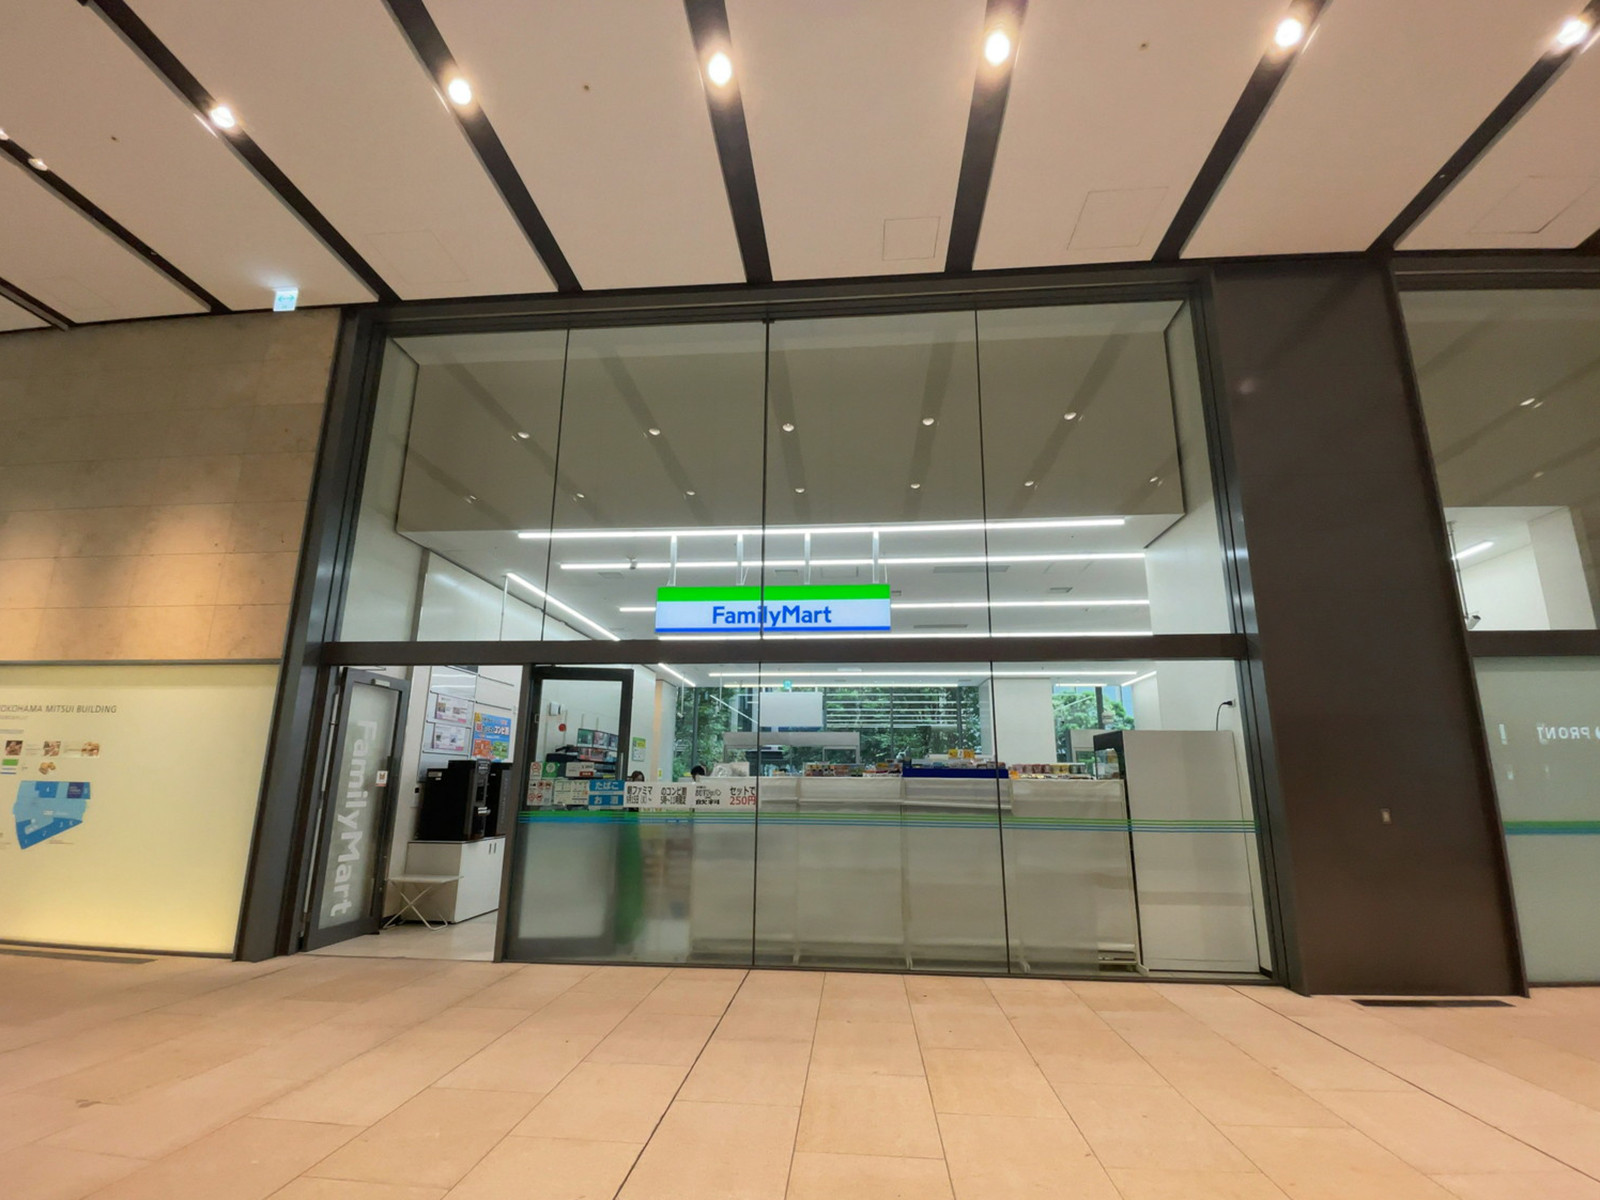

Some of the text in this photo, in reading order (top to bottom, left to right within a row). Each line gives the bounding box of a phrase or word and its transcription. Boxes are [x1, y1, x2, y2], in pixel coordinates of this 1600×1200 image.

[712, 605, 832, 627] FamilyMart
[45, 705, 74, 713] MITSUI
[76, 705, 118, 713] BUILDING
[595, 781, 619, 791] たばこ
[729, 786, 755, 796] セットで
[729, 796, 757, 806] 250円
[330, 719, 378, 917] FamilyMart
